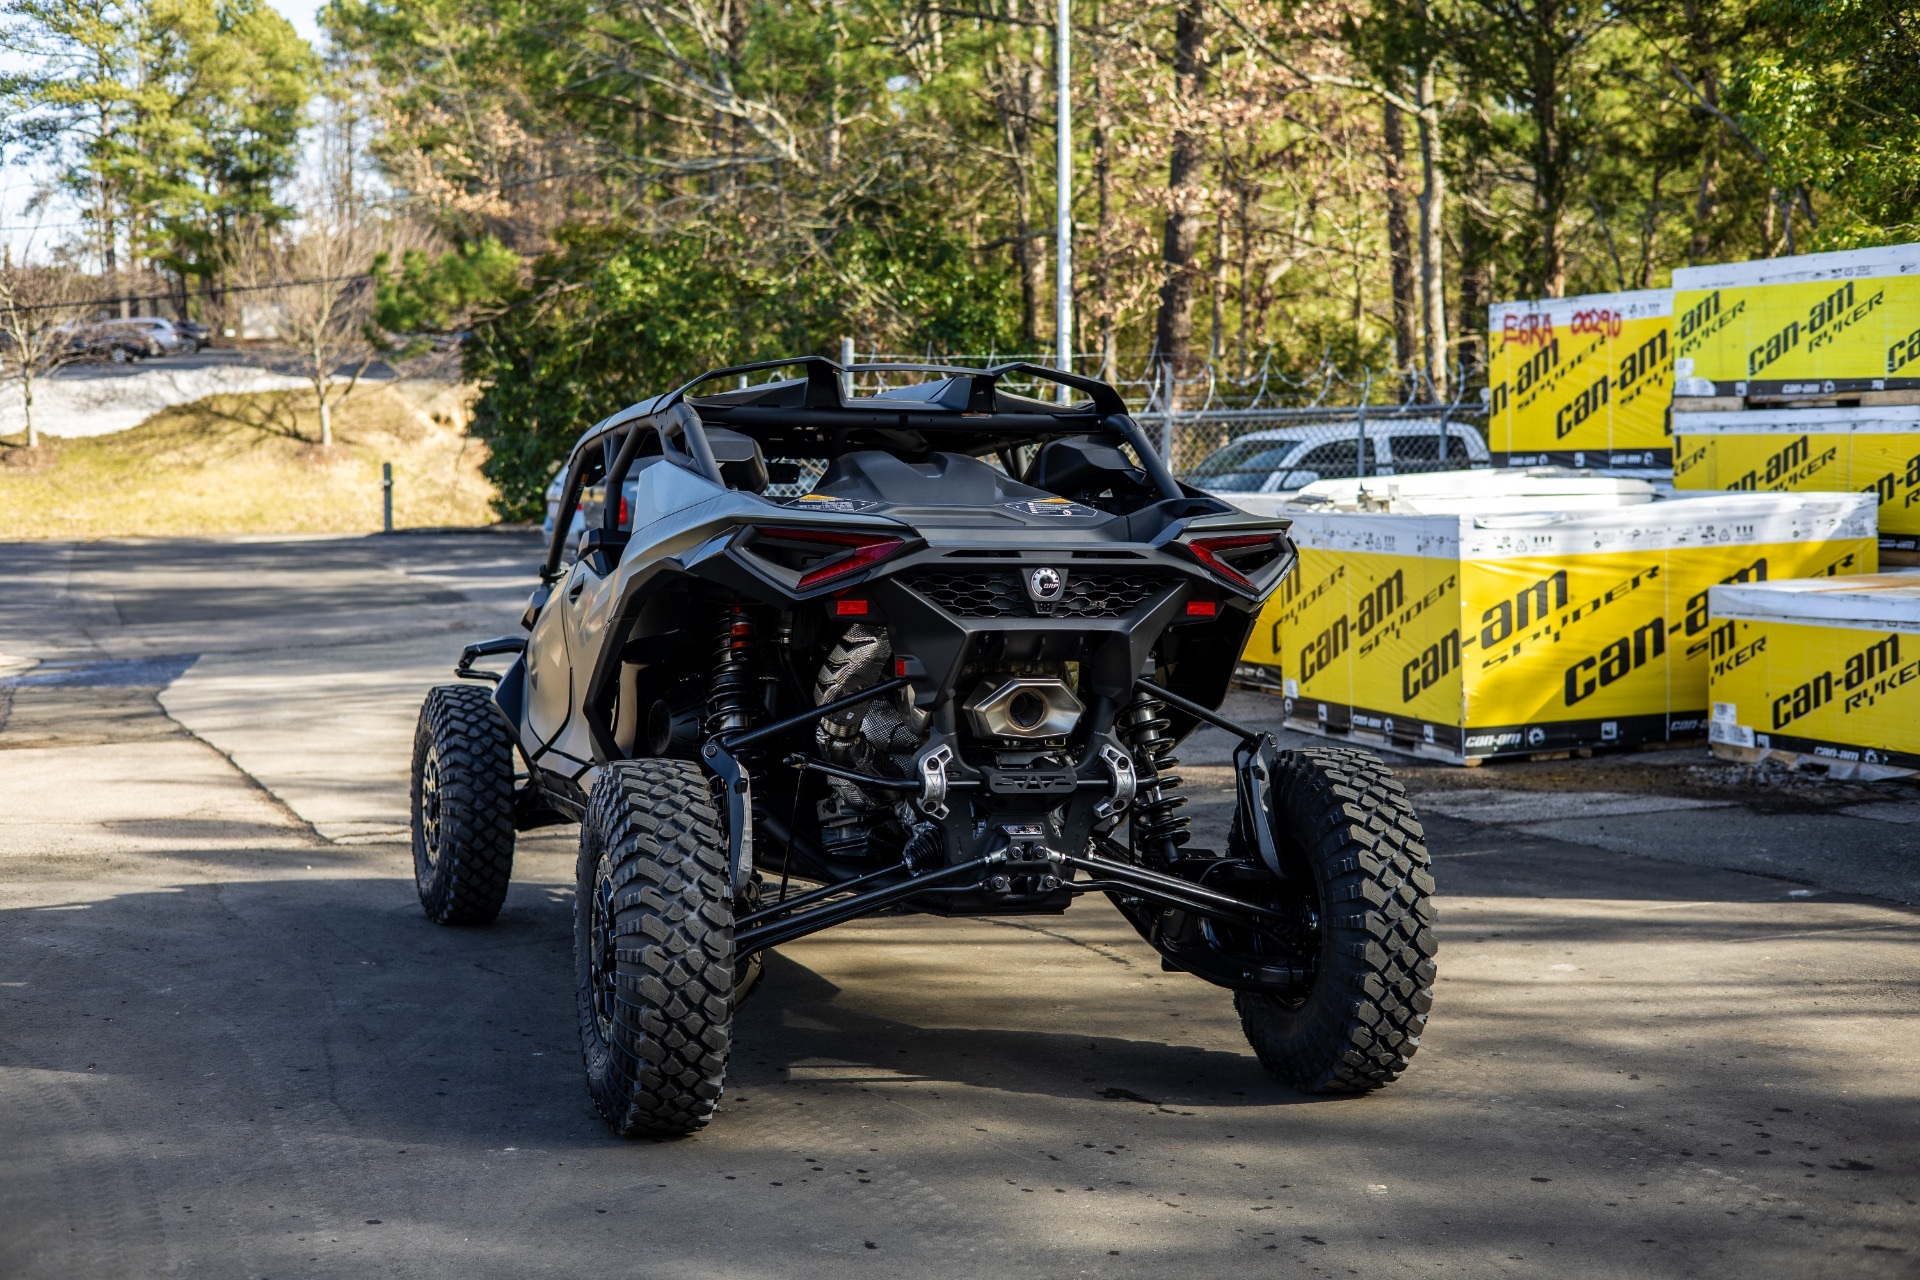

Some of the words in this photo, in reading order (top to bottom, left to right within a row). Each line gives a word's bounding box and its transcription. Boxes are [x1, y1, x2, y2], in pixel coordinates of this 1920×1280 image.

[1680, 299, 1745, 358] RYKER
[1749, 281, 1854, 377] can-am
[1808, 290, 1884, 353] RYKER
[1556, 328, 1667, 440] can-am
[1300, 568, 1403, 684] can-am
[1359, 574, 1455, 659] SPYDER
[1482, 565, 1660, 674] SPYDER
[1772, 633, 1900, 730] can-am
[1844, 660, 1920, 714] RYKE
[1465, 732, 1522, 748] can-am
[1814, 746, 1859, 761] can-am
